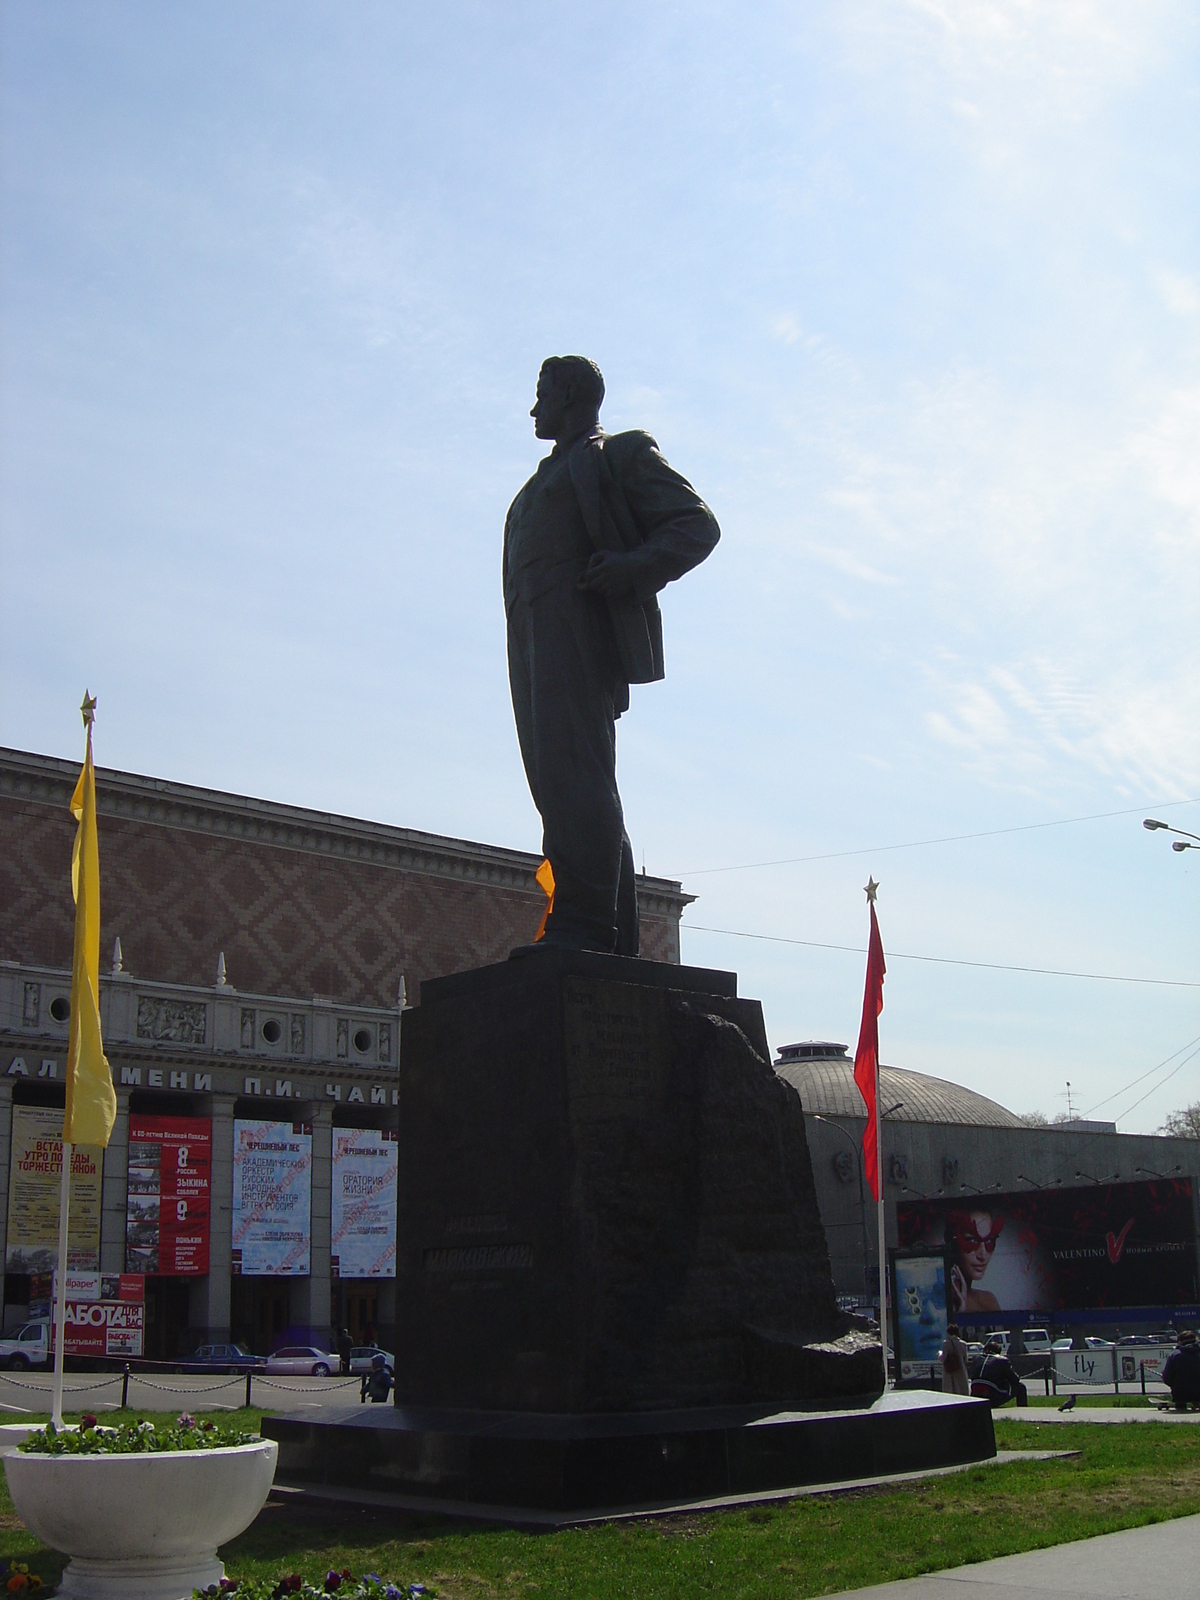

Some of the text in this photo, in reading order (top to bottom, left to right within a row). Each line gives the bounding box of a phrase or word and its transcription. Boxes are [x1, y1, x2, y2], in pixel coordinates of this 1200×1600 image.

[244, 1076, 301, 1099] П.И.
[36, 1141, 77, 1153] ВСТАНТ
[24, 1151, 91, 1165] УТРО ПОЕДЫ
[178, 1146, 189, 1168] 8
[17, 1160, 97, 1175] ТОРЖЕСТЕННОЙ
[242, 1166, 275, 1176] ОРКЕСТР
[176, 1178, 208, 1188] ЗЫКИНА
[242, 1175, 275, 1184] РУССКИХ
[343, 1174, 384, 1185] ОРАТОРИЯ
[242, 1183, 283, 1193] НАРОДНЫХ
[343, 1184, 373, 1195] ЖИЗНИ
[177, 1200, 188, 1221] 9
[1053, 1248, 1106, 1259] VALENTINO
[53, 1304, 127, 1327] АБОТА
[1074, 1354, 1095, 1377] fly
